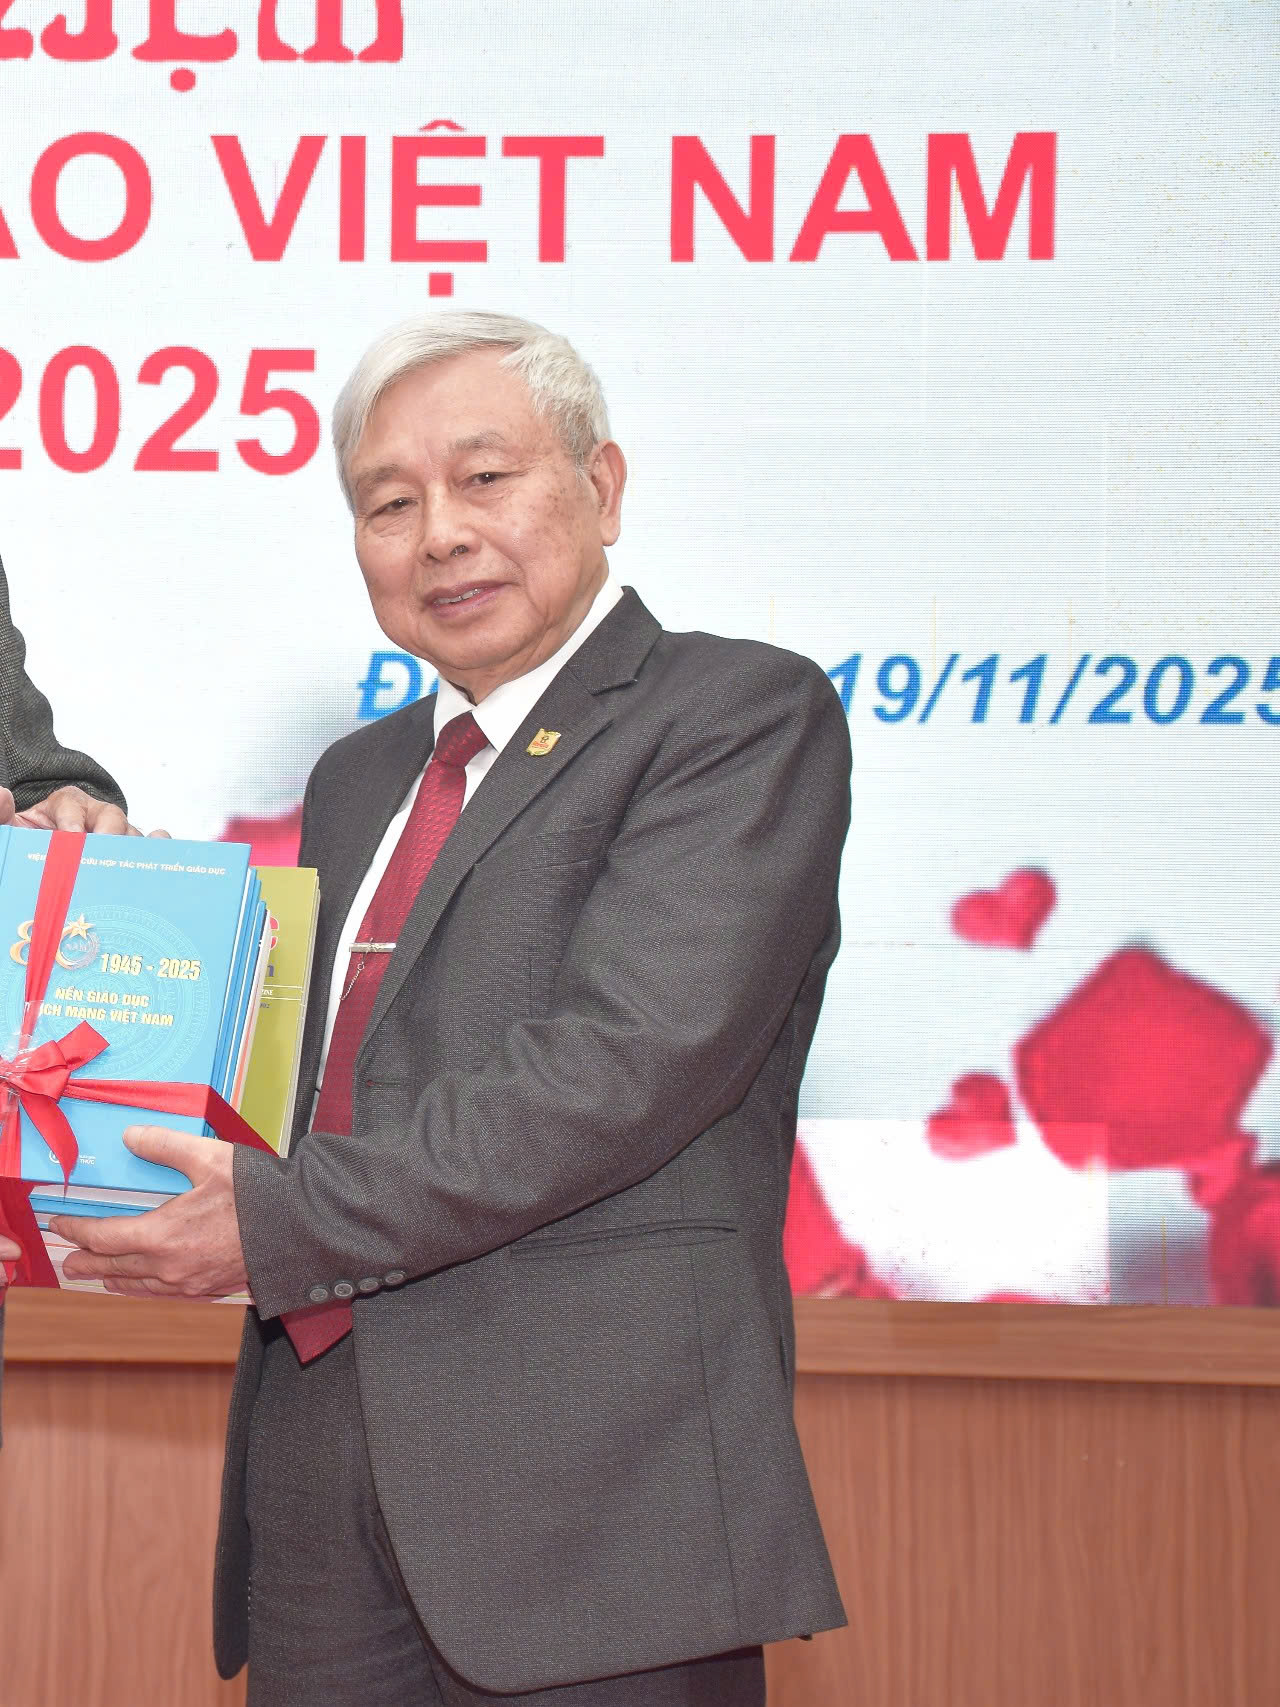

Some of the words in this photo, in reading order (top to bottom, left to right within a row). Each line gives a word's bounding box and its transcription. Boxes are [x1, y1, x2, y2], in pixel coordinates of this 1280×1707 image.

[210, 119, 606, 298] VIỆT
[669, 131, 1058, 263] NAM
[186, 864, 207, 873] GIÁO
[207, 866, 226, 875] DỤC
[101, 952, 143, 976] 1945
[157, 957, 201, 981] 2025
[141, 1011, 174, 1027] NAM
